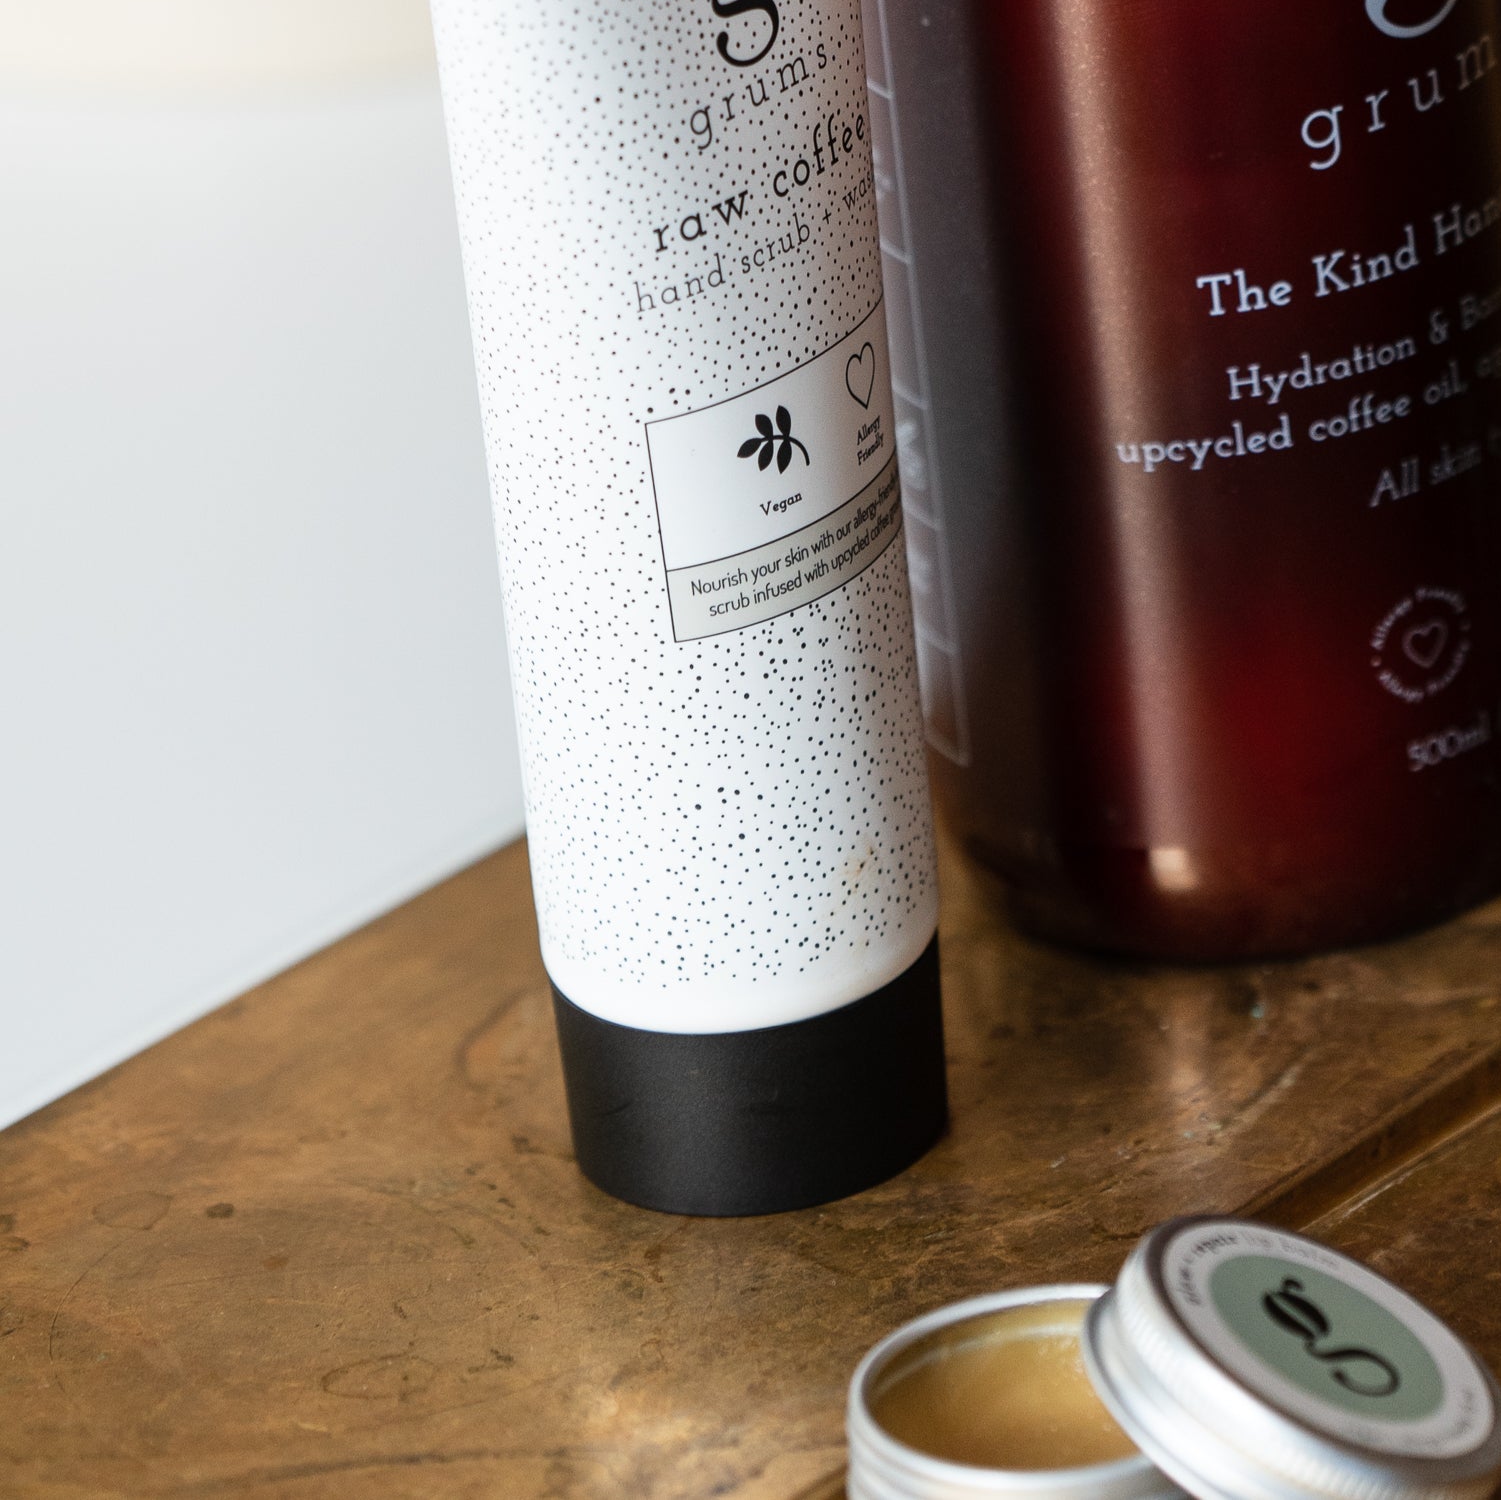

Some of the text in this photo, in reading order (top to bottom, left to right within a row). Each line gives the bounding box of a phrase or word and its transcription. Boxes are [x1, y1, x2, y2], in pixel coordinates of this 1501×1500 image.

[688, 43, 829, 150] grums
[653, 189, 749, 253] raw
[773, 112, 865, 199] coffee
[633, 253, 727, 313] hand
[740, 213, 811, 275] scrub
[842, 171, 871, 211] was
[1196, 268, 1293, 317] The
[1311, 225, 1419, 299] Kind
[1226, 335, 1417, 405] Hydration
[1429, 309, 1450, 346] &
[856, 414, 882, 446] Allergy
[857, 433, 884, 466] Friendly
[1115, 414, 1294, 473] upcycled
[1308, 393, 1412, 443] coffee
[760, 492, 803, 517] Vegan
[1368, 456, 1420, 508] All
[691, 568, 748, 597] Nourish
[751, 559, 782, 590] your
[784, 546, 810, 569] skin
[811, 530, 834, 554] with
[836, 521, 852, 541] our
[709, 593, 751, 618] scrub
[753, 569, 802, 605] infused
[804, 559, 830, 584] with
[831, 528, 870, 572] upcycled
